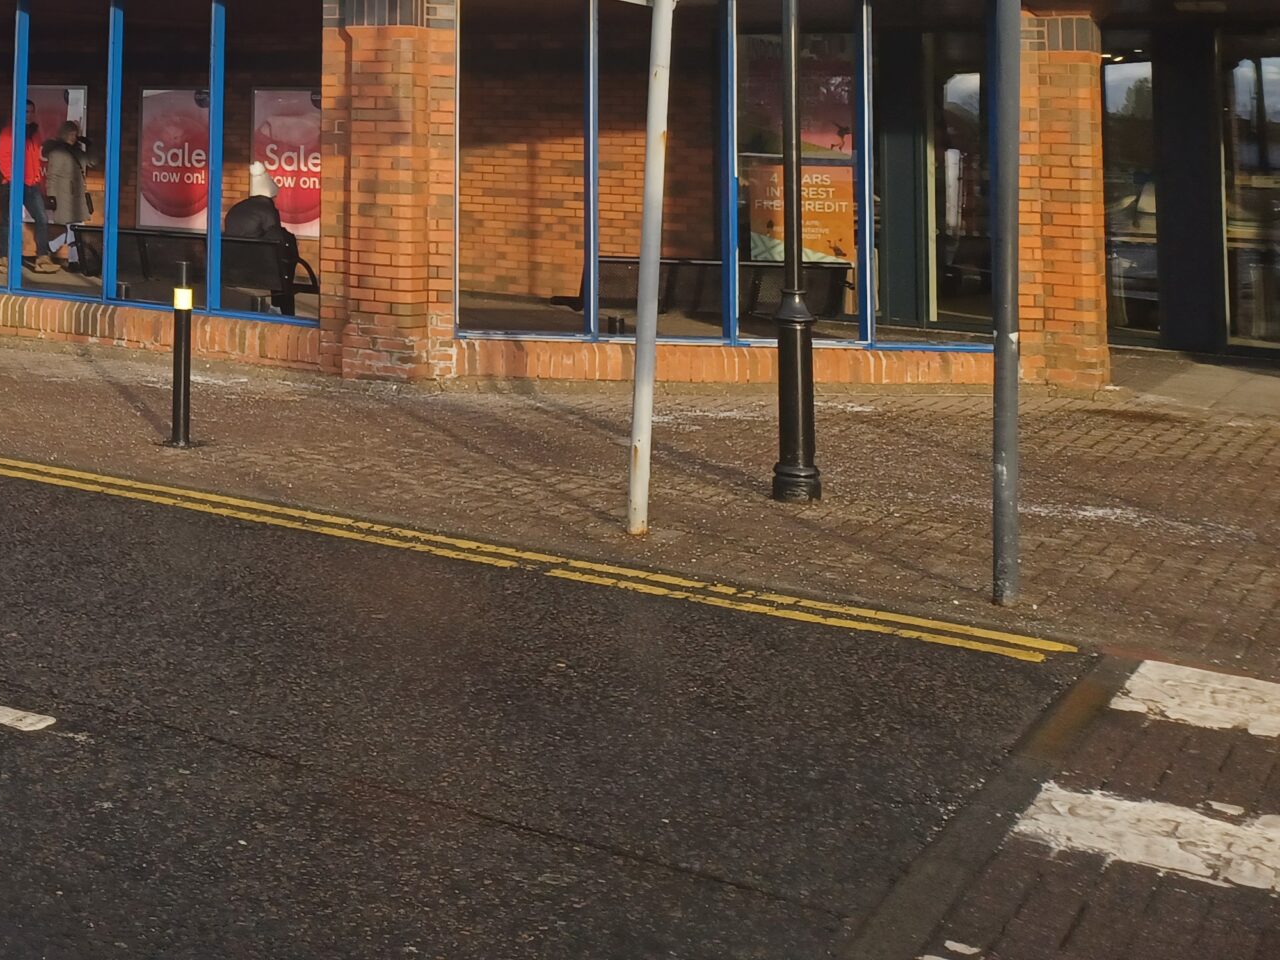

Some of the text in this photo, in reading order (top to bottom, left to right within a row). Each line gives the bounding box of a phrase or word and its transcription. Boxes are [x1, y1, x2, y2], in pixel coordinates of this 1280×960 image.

[152, 140, 206, 168] Sale
[264, 143, 321, 172] Sale
[152, 170, 206, 184] now on!
[273, 175, 296, 188] ow
[769, 172, 831, 185] 4 ARS
[766, 186, 835, 198] INREST
[754, 199, 848, 213] FRE REDIT
